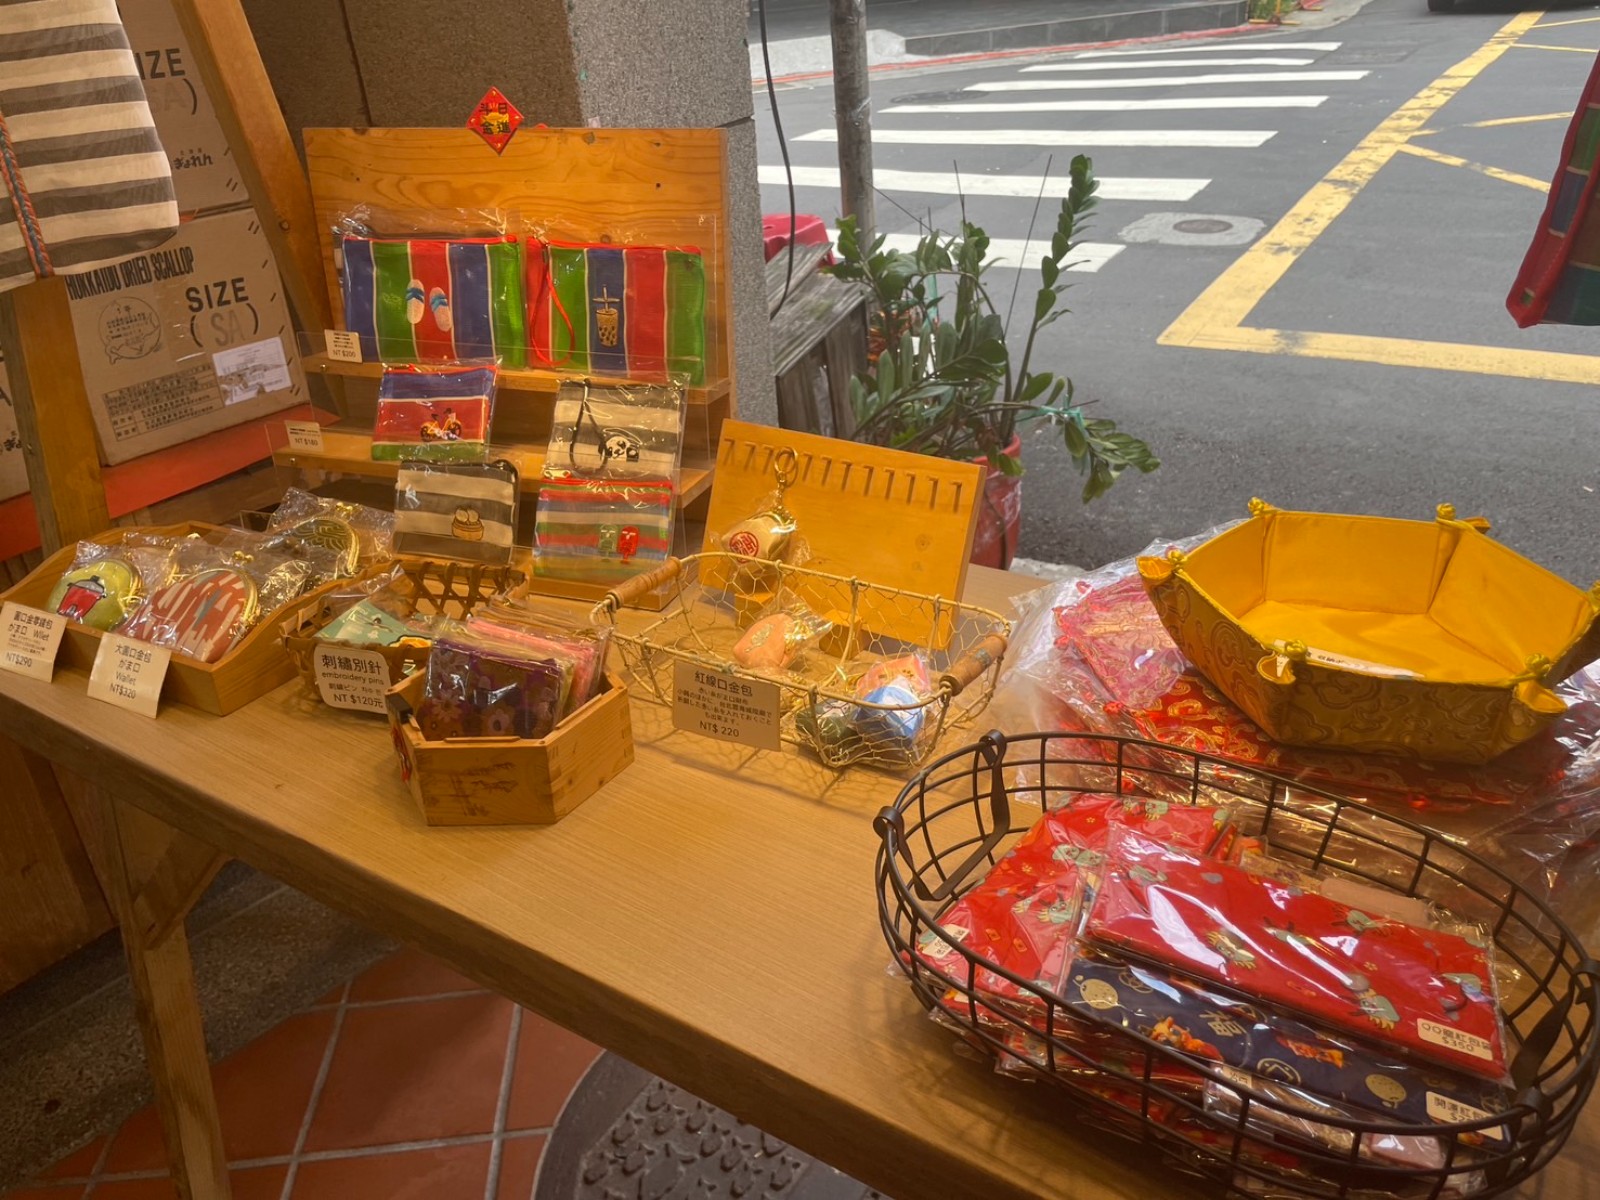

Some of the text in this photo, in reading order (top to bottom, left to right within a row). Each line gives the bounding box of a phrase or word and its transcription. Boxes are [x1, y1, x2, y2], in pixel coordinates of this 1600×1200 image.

[134, 48, 185, 80] IZE
[119, 255, 152, 290] DRIED
[151, 246, 195, 281] SCALLOP
[185, 277, 249, 313] SIZE
[8, 623, 28, 636] がま口
[6, 652, 33, 668] NT$290
[118, 659, 142, 673] がま口
[116, 671, 137, 686] Wallet
[321, 672, 384, 686] embroidery pins
[694, 670, 753, 697] 紅線口金包
[110, 683, 137, 700] NT$320
[333, 693, 347, 702] NT
[699, 720, 741, 738] NT$ 220
[1441, 1036, 1475, 1052] $350
